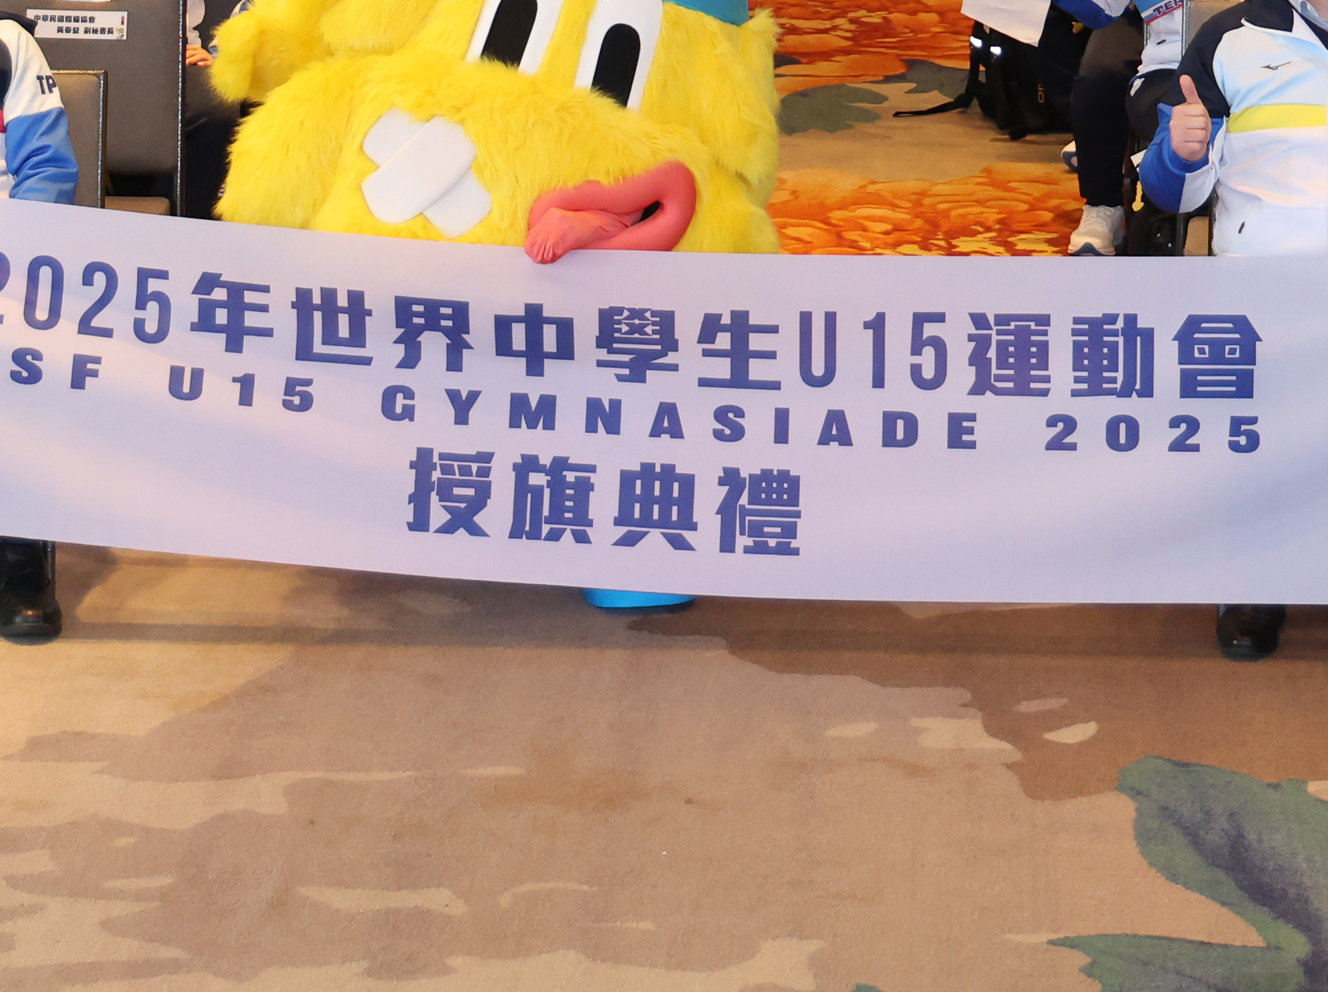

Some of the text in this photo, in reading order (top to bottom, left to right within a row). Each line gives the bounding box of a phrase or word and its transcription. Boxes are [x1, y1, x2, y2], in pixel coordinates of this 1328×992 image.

[36, 75, 58, 95] TP
[169, 364, 315, 413] U15
[381, 386, 979, 451] GYMNASIADE
[1045, 413, 1262, 455] 2025
[405, 446, 804, 558] 授旗典禮
